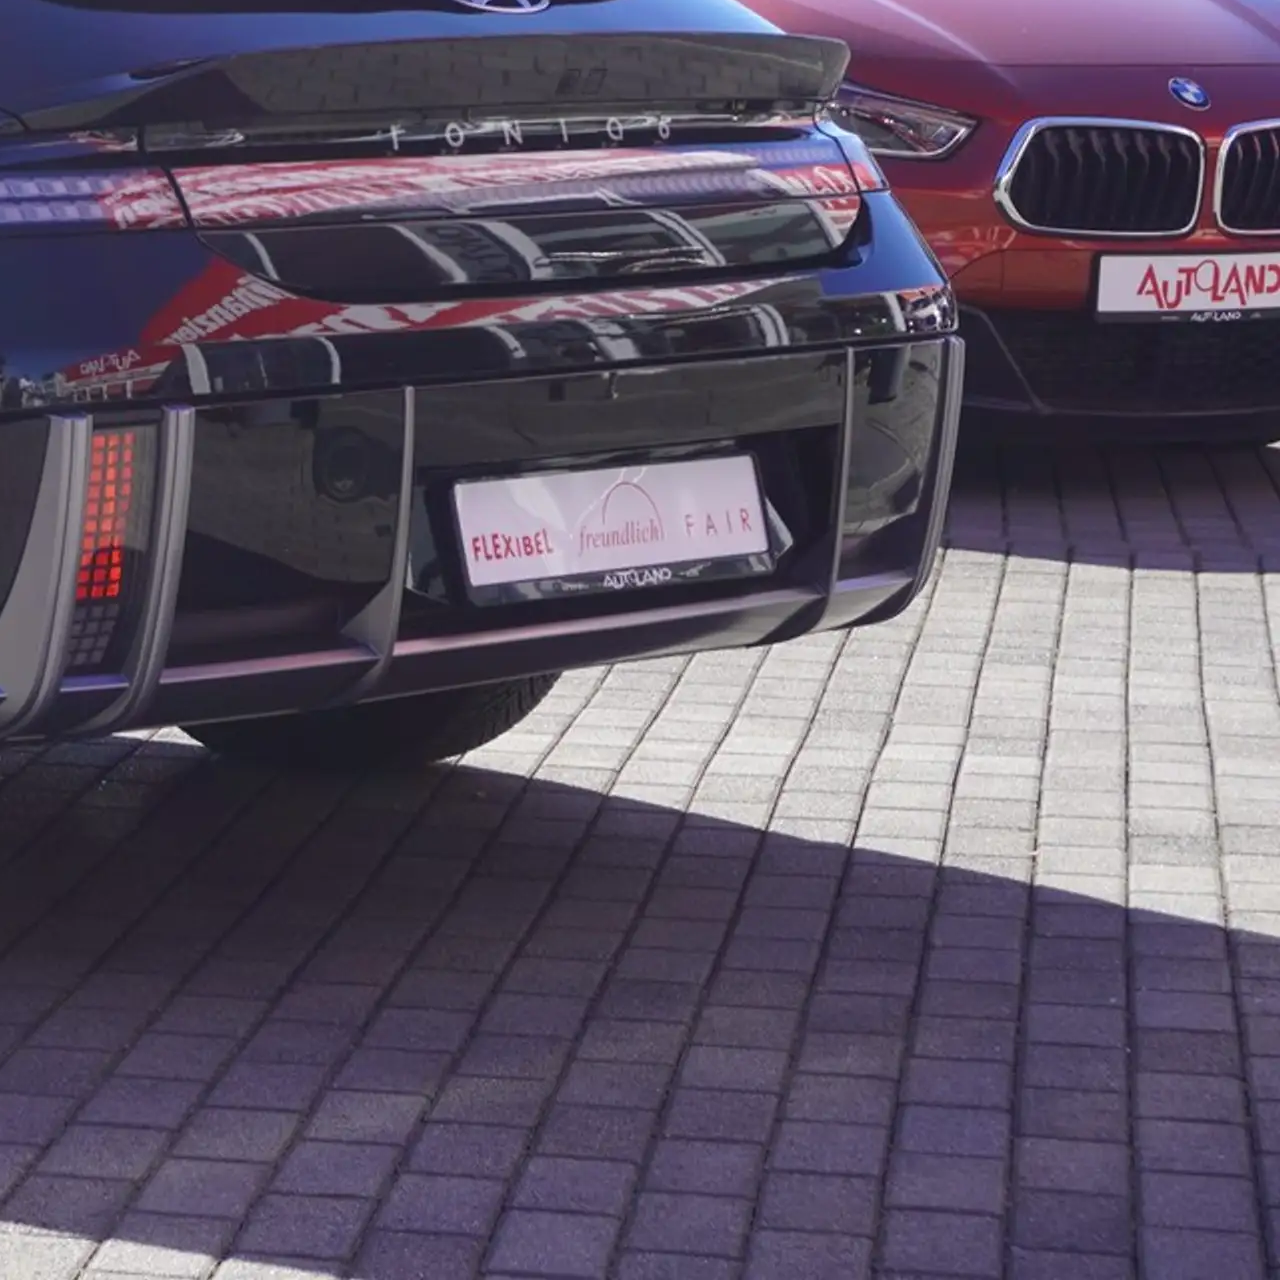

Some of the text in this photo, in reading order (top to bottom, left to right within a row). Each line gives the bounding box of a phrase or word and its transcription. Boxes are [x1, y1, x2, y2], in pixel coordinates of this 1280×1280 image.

[471, 507, 753, 562] FLEXIBEL freundlich FAIR
[603, 567, 673, 590] AUTOLAND
